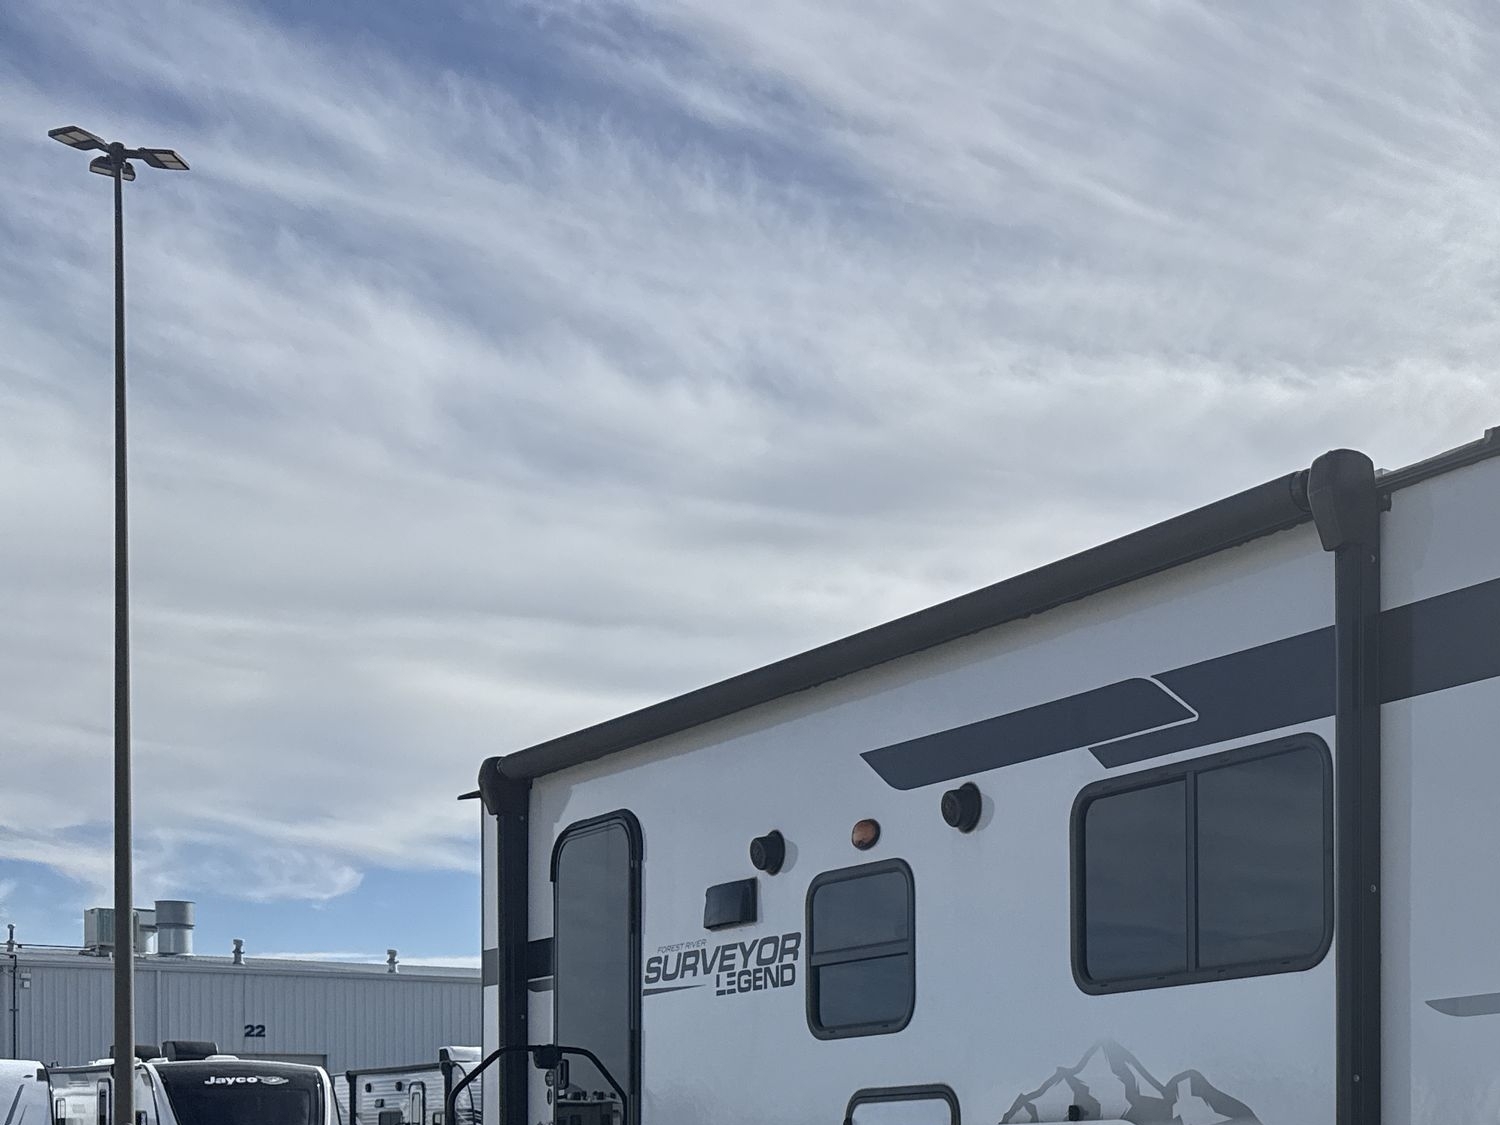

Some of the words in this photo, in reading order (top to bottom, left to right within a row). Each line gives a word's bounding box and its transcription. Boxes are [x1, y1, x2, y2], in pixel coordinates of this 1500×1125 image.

[657, 942, 685, 954] FOREST
[685, 938, 708, 949] RIVER
[644, 931, 802, 985] SURVEYOR
[716, 963, 796, 996] LEGEND
[244, 1024, 266, 1037] 22
[204, 1076, 258, 1086] Jayco
